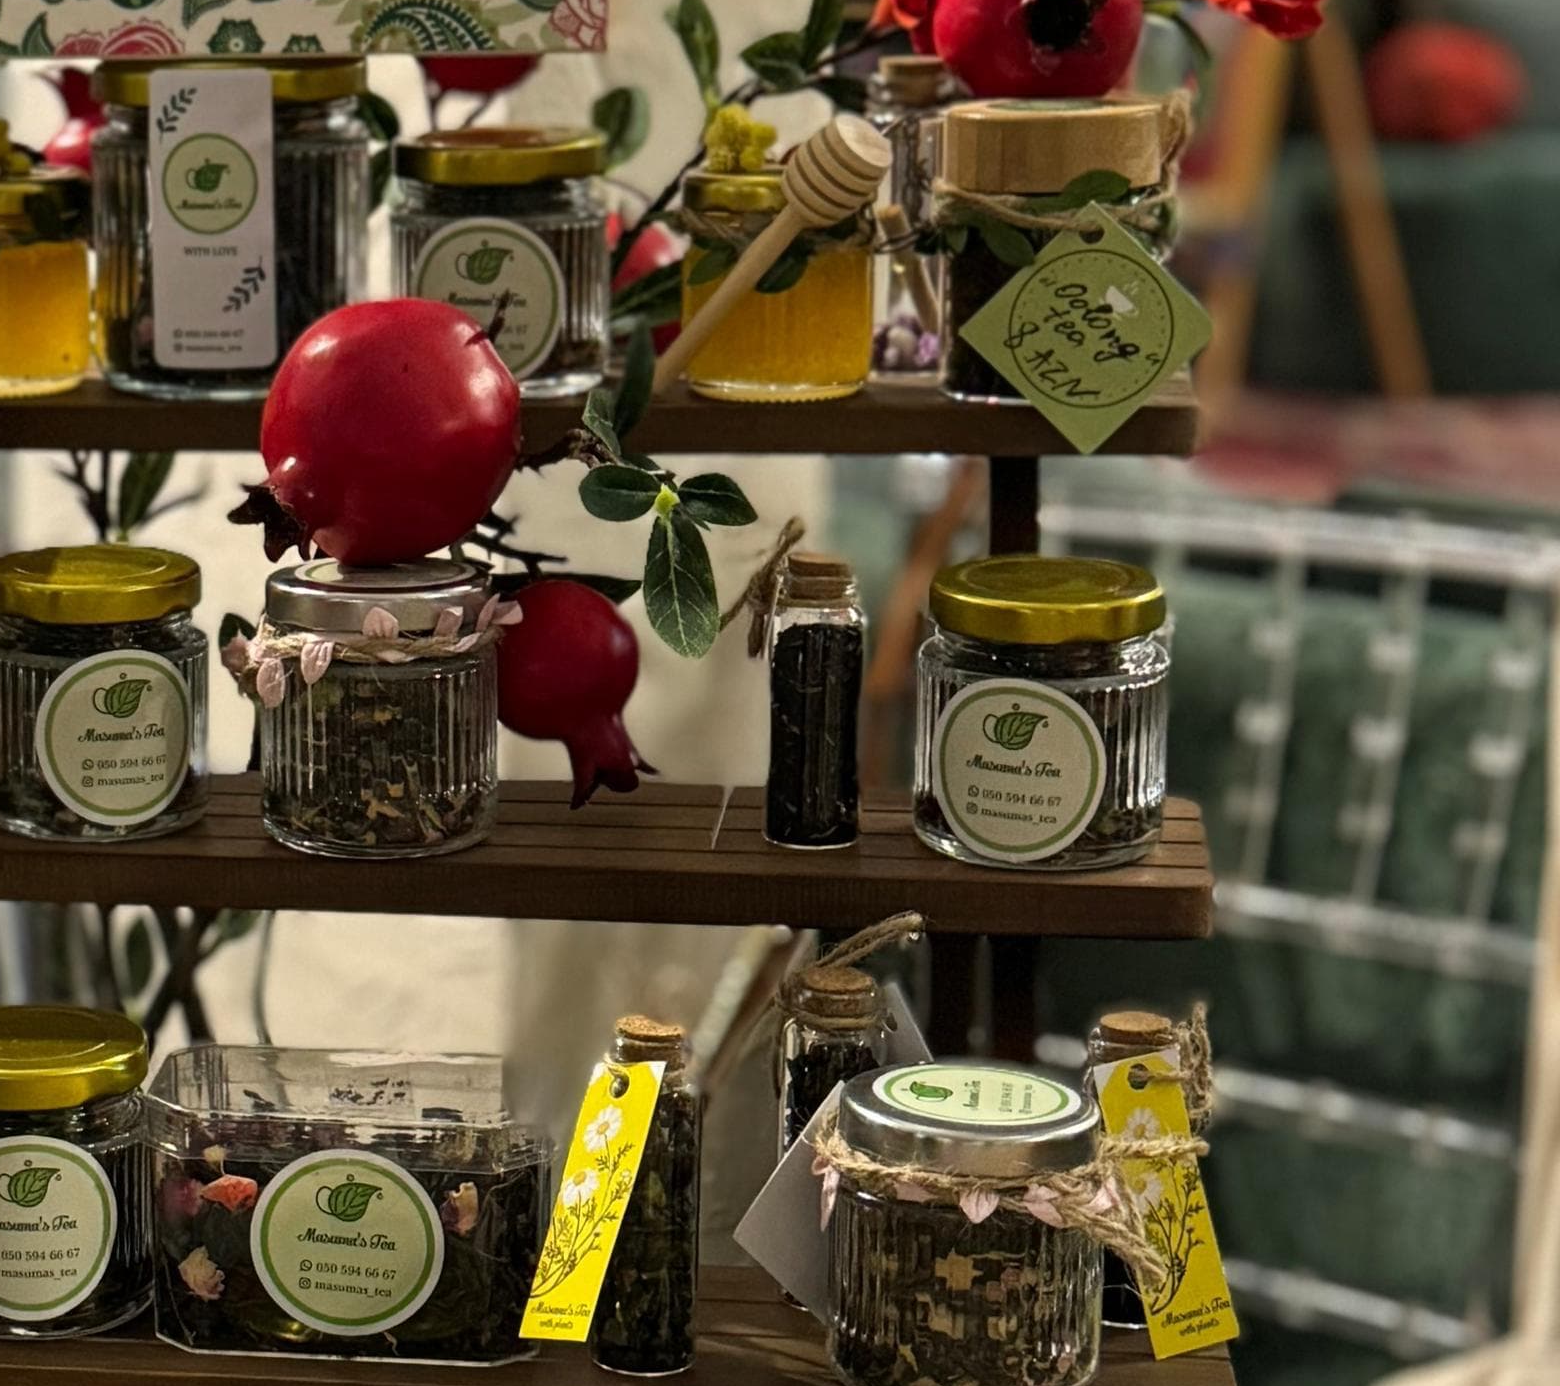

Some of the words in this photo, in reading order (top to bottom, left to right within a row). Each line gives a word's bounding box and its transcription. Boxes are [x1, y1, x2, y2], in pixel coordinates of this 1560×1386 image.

[78, 726, 142, 743] Masuma's
[144, 723, 165, 739] Tea
[966, 754, 1032, 776] Masuma's
[1035, 762, 1061, 778] Tea
[52, 1214, 78, 1232] Tea
[296, 1227, 367, 1248] Masuma's
[369, 1233, 397, 1251] Tea
[1, 1250, 22, 1261] 050
[25, 1251, 46, 1261] 594
[49, 1249, 63, 1260] 66
[66, 1247, 80, 1258] 67
[316, 1262, 338, 1274] 050
[340, 1264, 361, 1276] 594
[365, 1267, 379, 1278] 66
[382, 1269, 397, 1280] 67
